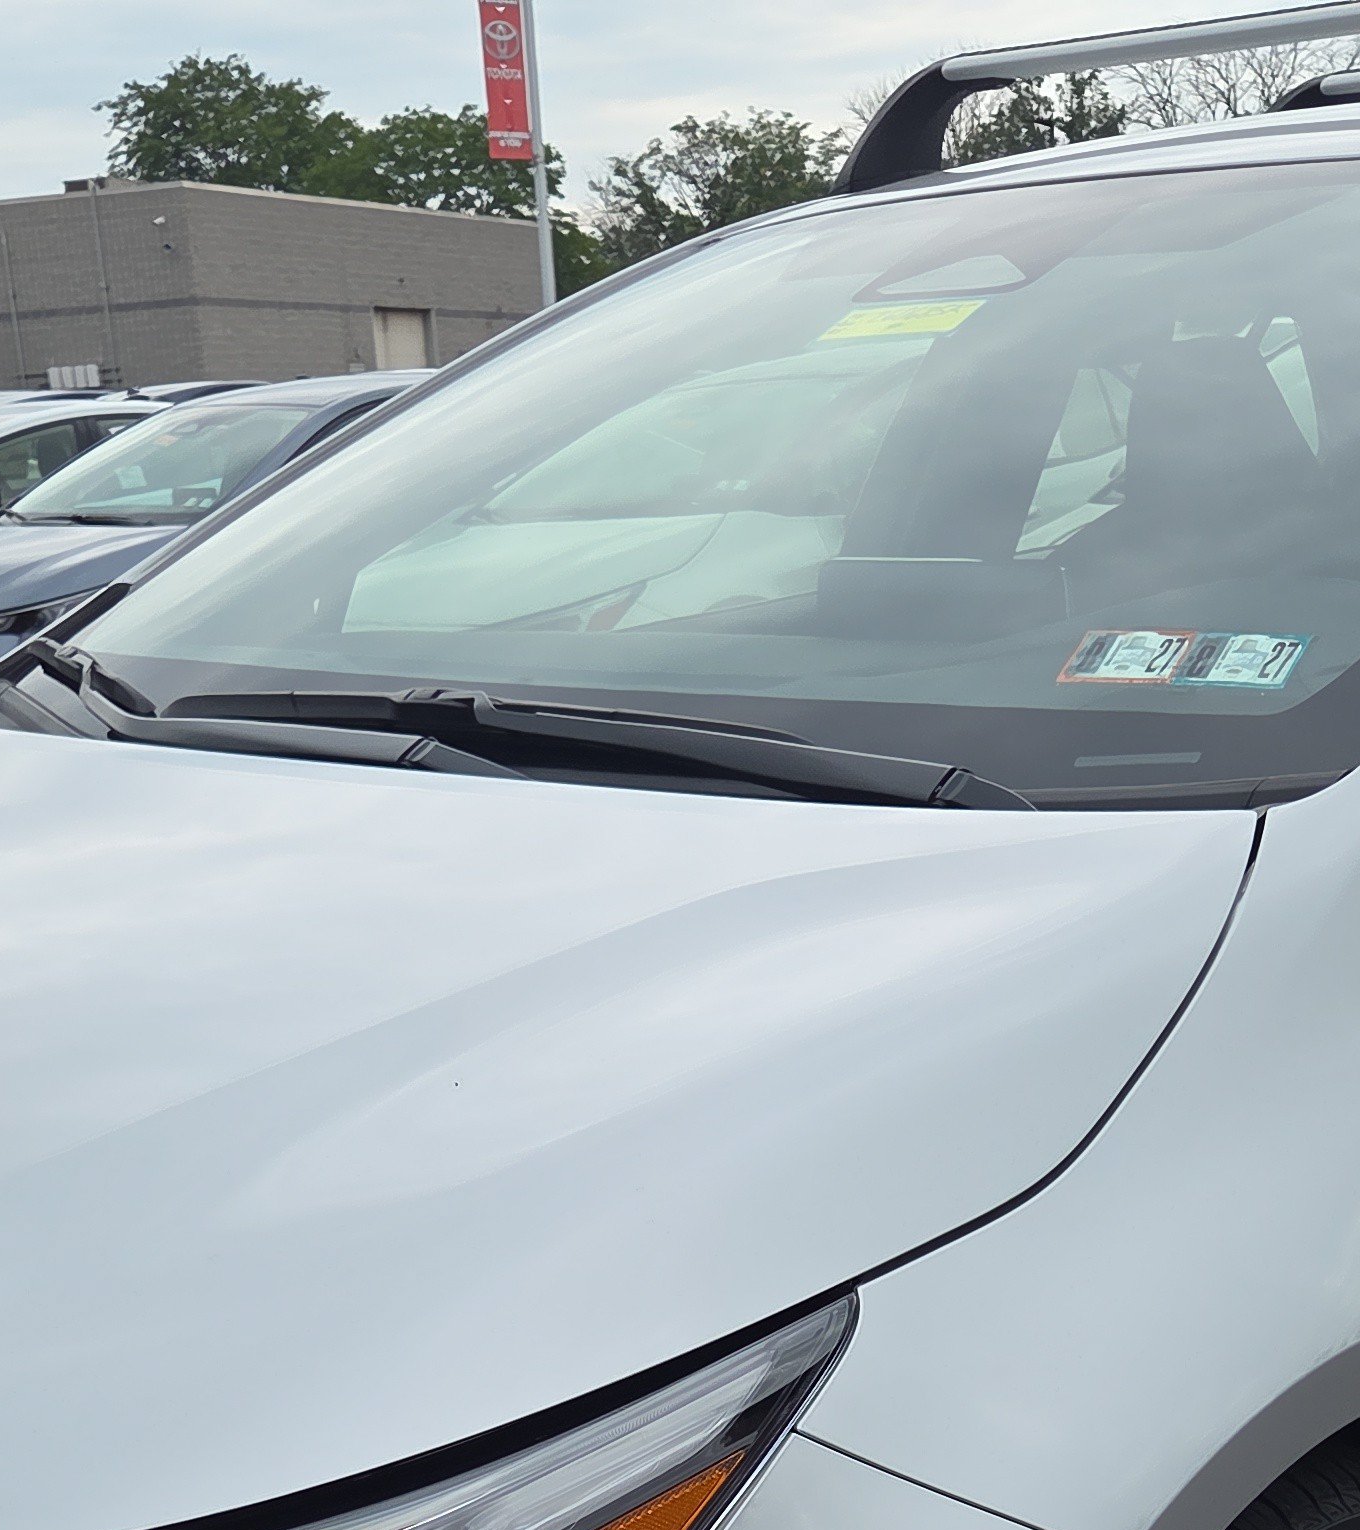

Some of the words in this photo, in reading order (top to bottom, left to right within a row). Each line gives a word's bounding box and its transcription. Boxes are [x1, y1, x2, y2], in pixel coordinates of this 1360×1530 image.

[487, 67, 522, 80] TOYOTA
[1144, 637, 1188, 676] 27
[1257, 642, 1301, 681] 27
